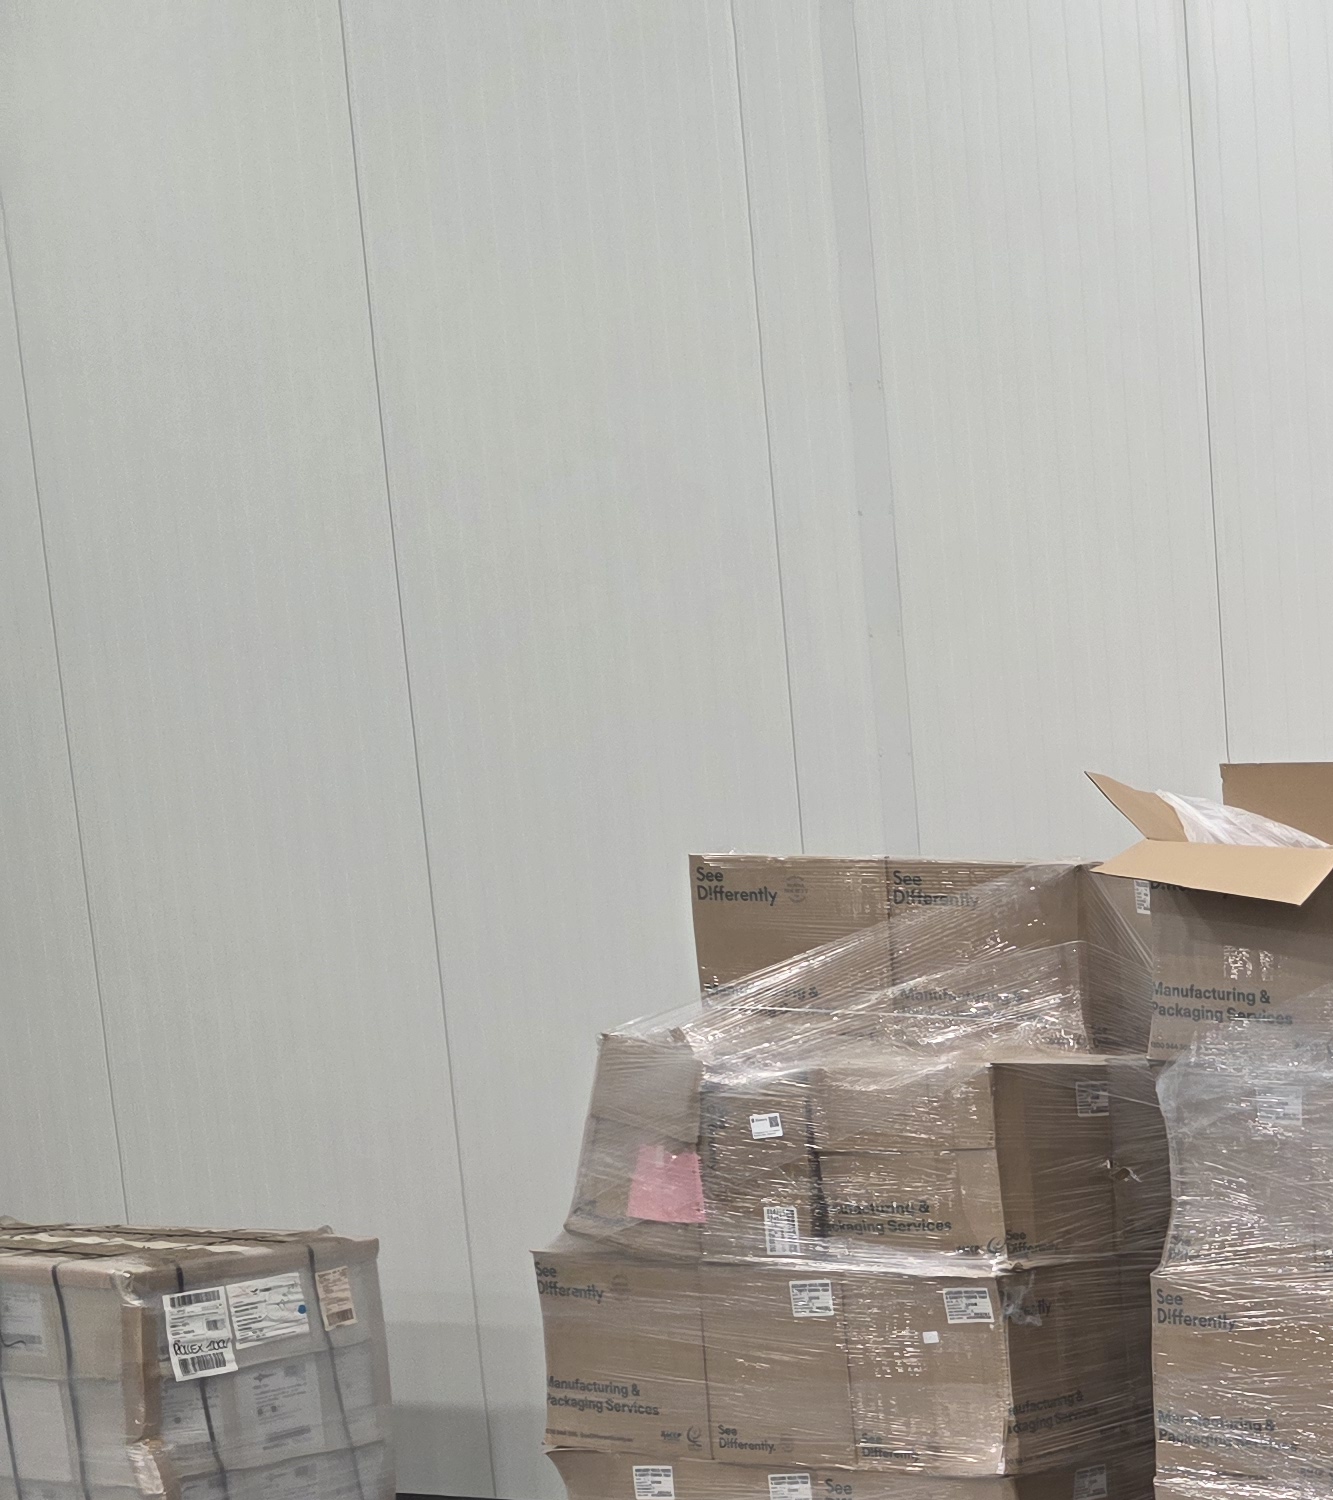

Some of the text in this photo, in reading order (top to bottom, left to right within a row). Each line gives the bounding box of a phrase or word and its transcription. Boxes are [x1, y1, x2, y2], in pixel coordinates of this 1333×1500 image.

[697, 867, 723, 881] See
[894, 871, 922, 885] See
[1152, 982, 1271, 1006] Manufacturing &
[1151, 1002, 1224, 1023] Packaging
[535, 1262, 557, 1278] See
[1157, 1289, 1183, 1306] See
[631, 1383, 641, 1397] &
[605, 1399, 660, 1416] Services
[718, 1424, 738, 1436] See
[824, 1478, 853, 1494] See
